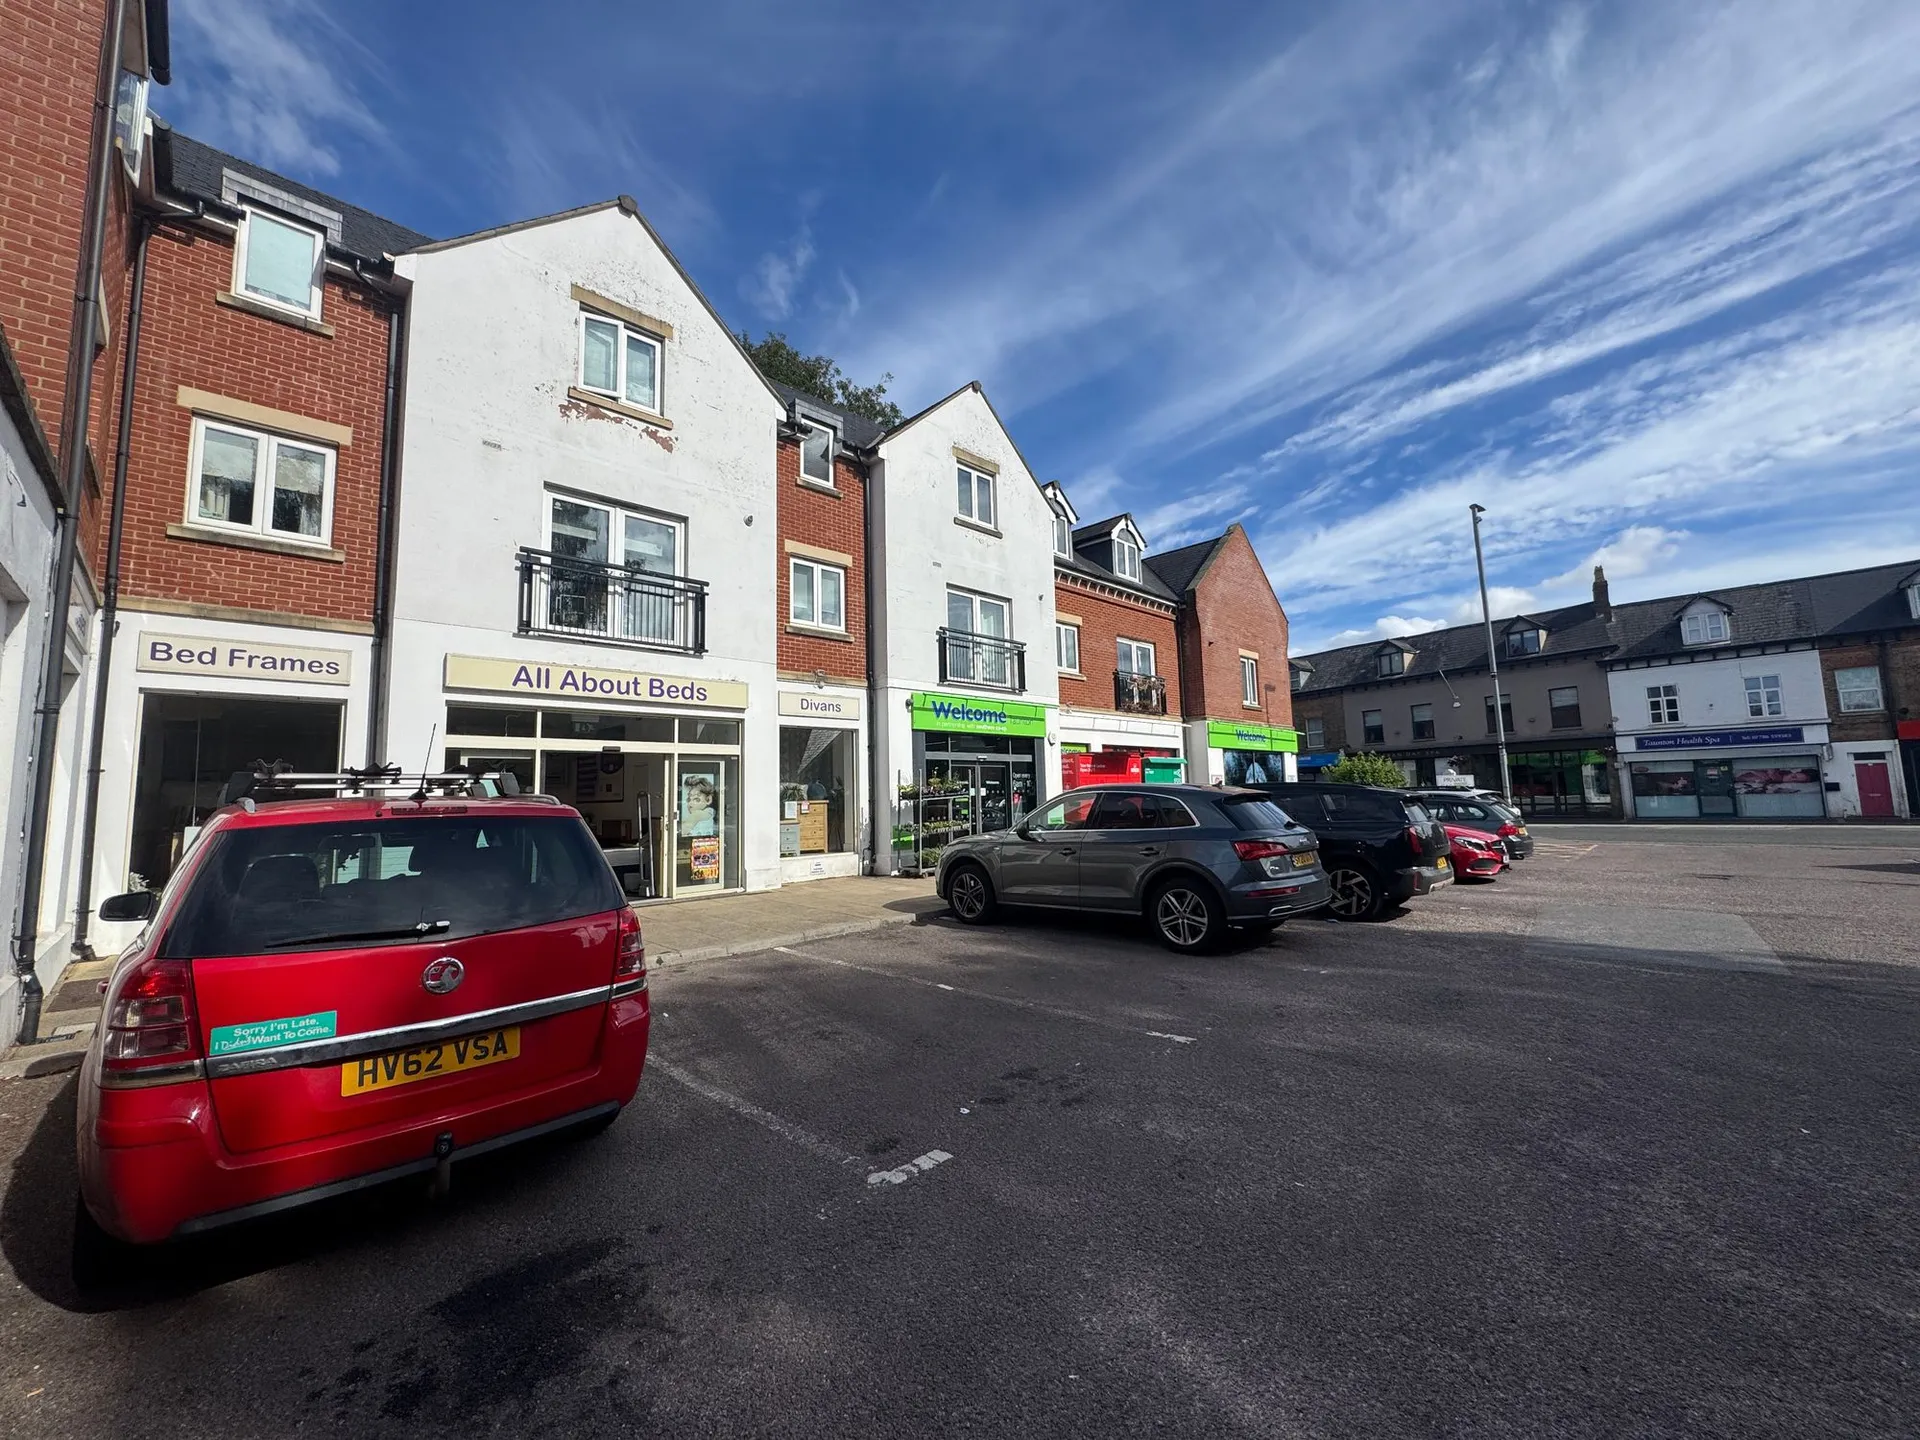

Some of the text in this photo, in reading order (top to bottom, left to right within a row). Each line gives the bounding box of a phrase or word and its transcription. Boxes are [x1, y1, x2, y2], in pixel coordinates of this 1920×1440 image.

[150, 641, 340, 675] Bed Frames
[512, 665, 708, 701] All About Beds
[800, 698, 842, 713] Divans
[932, 700, 1007, 724] Welcome
[1235, 729, 1267, 743] Welcome
[1643, 735, 1721, 747] Taunton Health Spa
[214, 1041, 219, 1050] I
[251, 1034, 281, 1045] Want
[284, 1031, 296, 1040] To
[297, 1026, 333, 1037] Come.
[233, 1017, 319, 1038] Sorry I'm Late.
[357, 1031, 509, 1088] HV62 VSA
